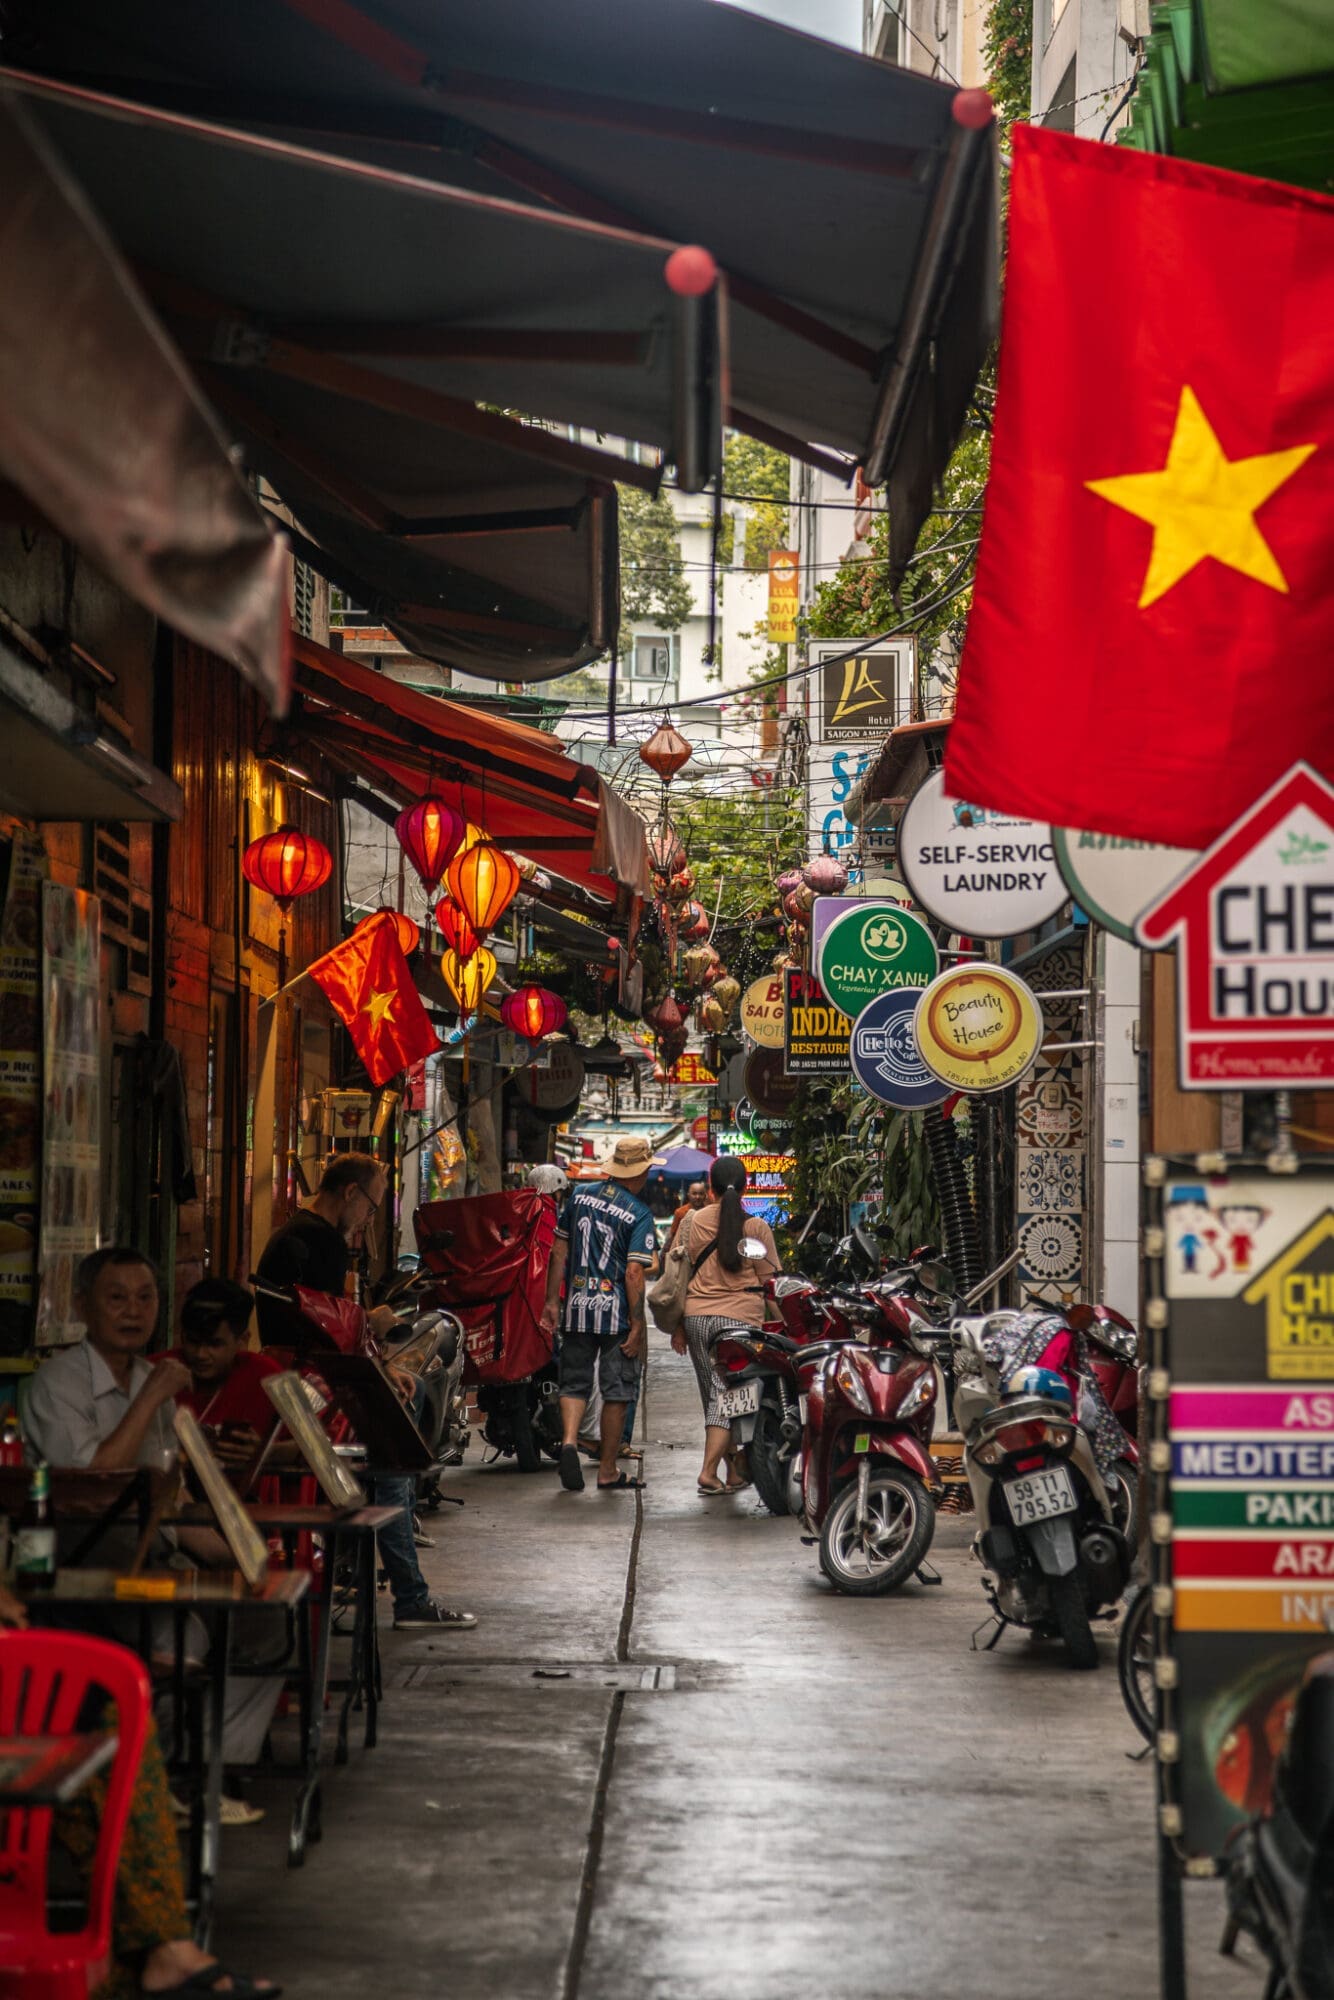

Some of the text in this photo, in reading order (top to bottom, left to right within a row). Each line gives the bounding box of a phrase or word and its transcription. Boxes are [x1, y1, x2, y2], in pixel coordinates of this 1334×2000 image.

[868, 715, 893, 725] Hotel
[827, 730, 860, 739] SAIGON
[919, 843, 1056, 865] SELF-SERVIC
[943, 872, 1047, 892] LAUNDRY
[1216, 885, 1334, 955] CHE
[830, 964, 929, 987] CHAY XANH
[746, 1005, 784, 1019] SAI G
[943, 993, 1003, 1022] Beauty
[791, 1007, 853, 1036] INDIA
[953, 1021, 1004, 1045] House
[790, 1043, 850, 1054] RESTAURA
[864, 1037, 903, 1050] Hello
[573, 1193, 637, 1225] THAILAND
[577, 1216, 615, 1271] 17
[1283, 1397, 1334, 1428] AS
[1181, 1444, 1334, 1475] MEDITER
[1014, 1474, 1058, 1501] 59-T1
[1014, 1491, 1072, 1522] 795.52
[1246, 1495, 1334, 1524] PAKI
